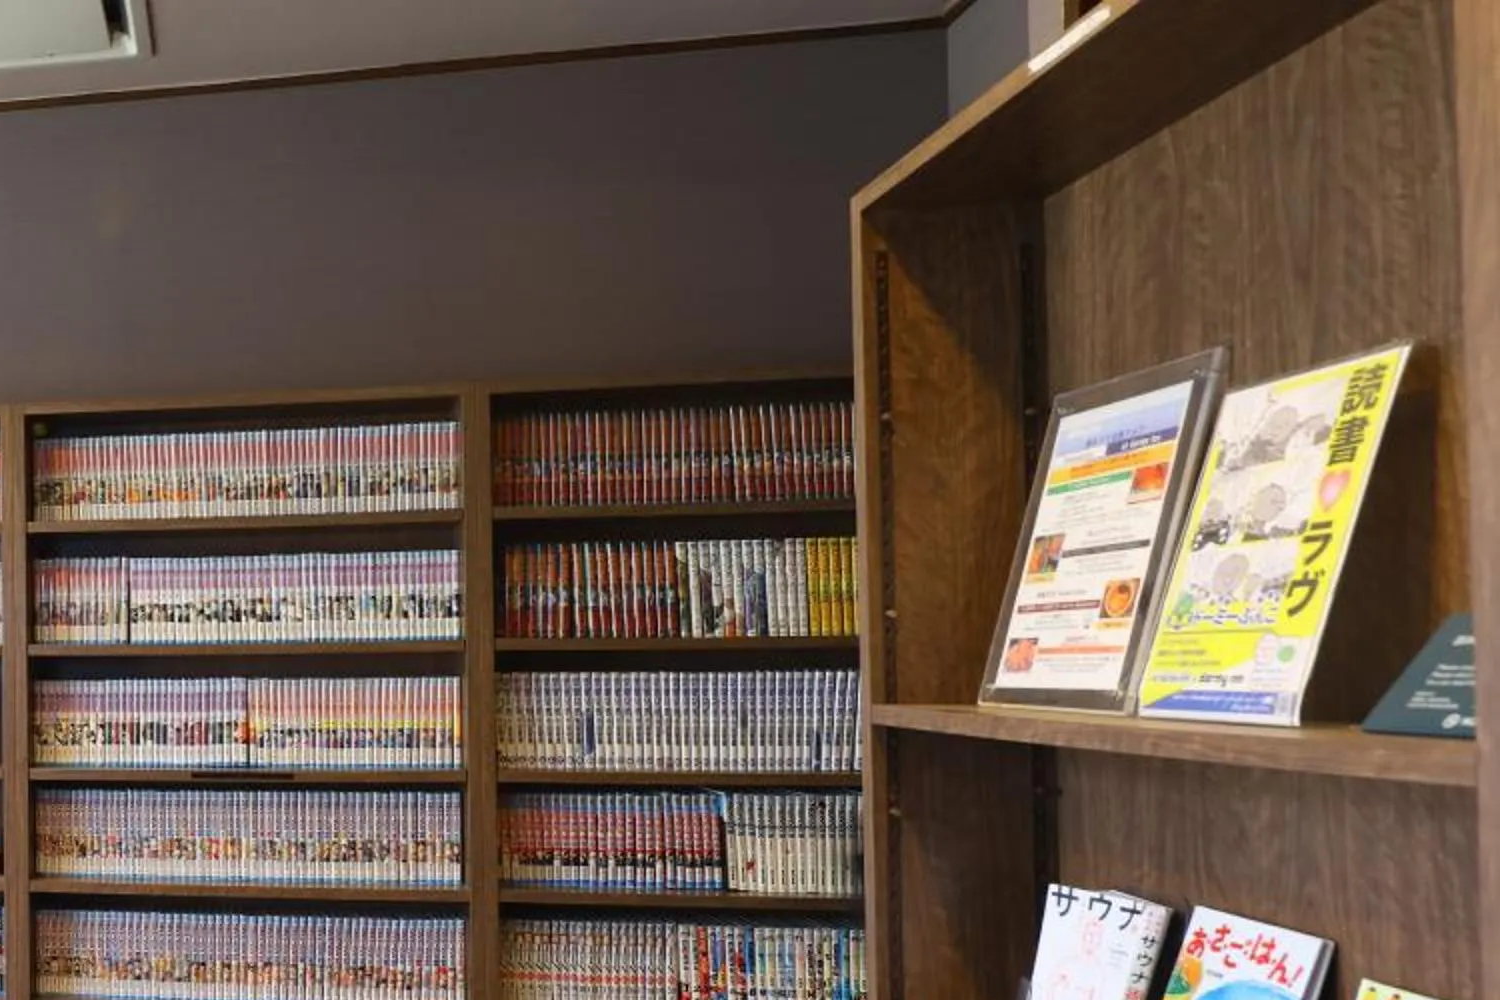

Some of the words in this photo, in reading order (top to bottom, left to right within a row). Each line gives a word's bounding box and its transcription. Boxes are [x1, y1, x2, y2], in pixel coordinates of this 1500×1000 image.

[1325, 363, 1389, 466] 読書
[1287, 520, 1334, 617] ラヴ
[1051, 886, 1143, 930] サウナ
